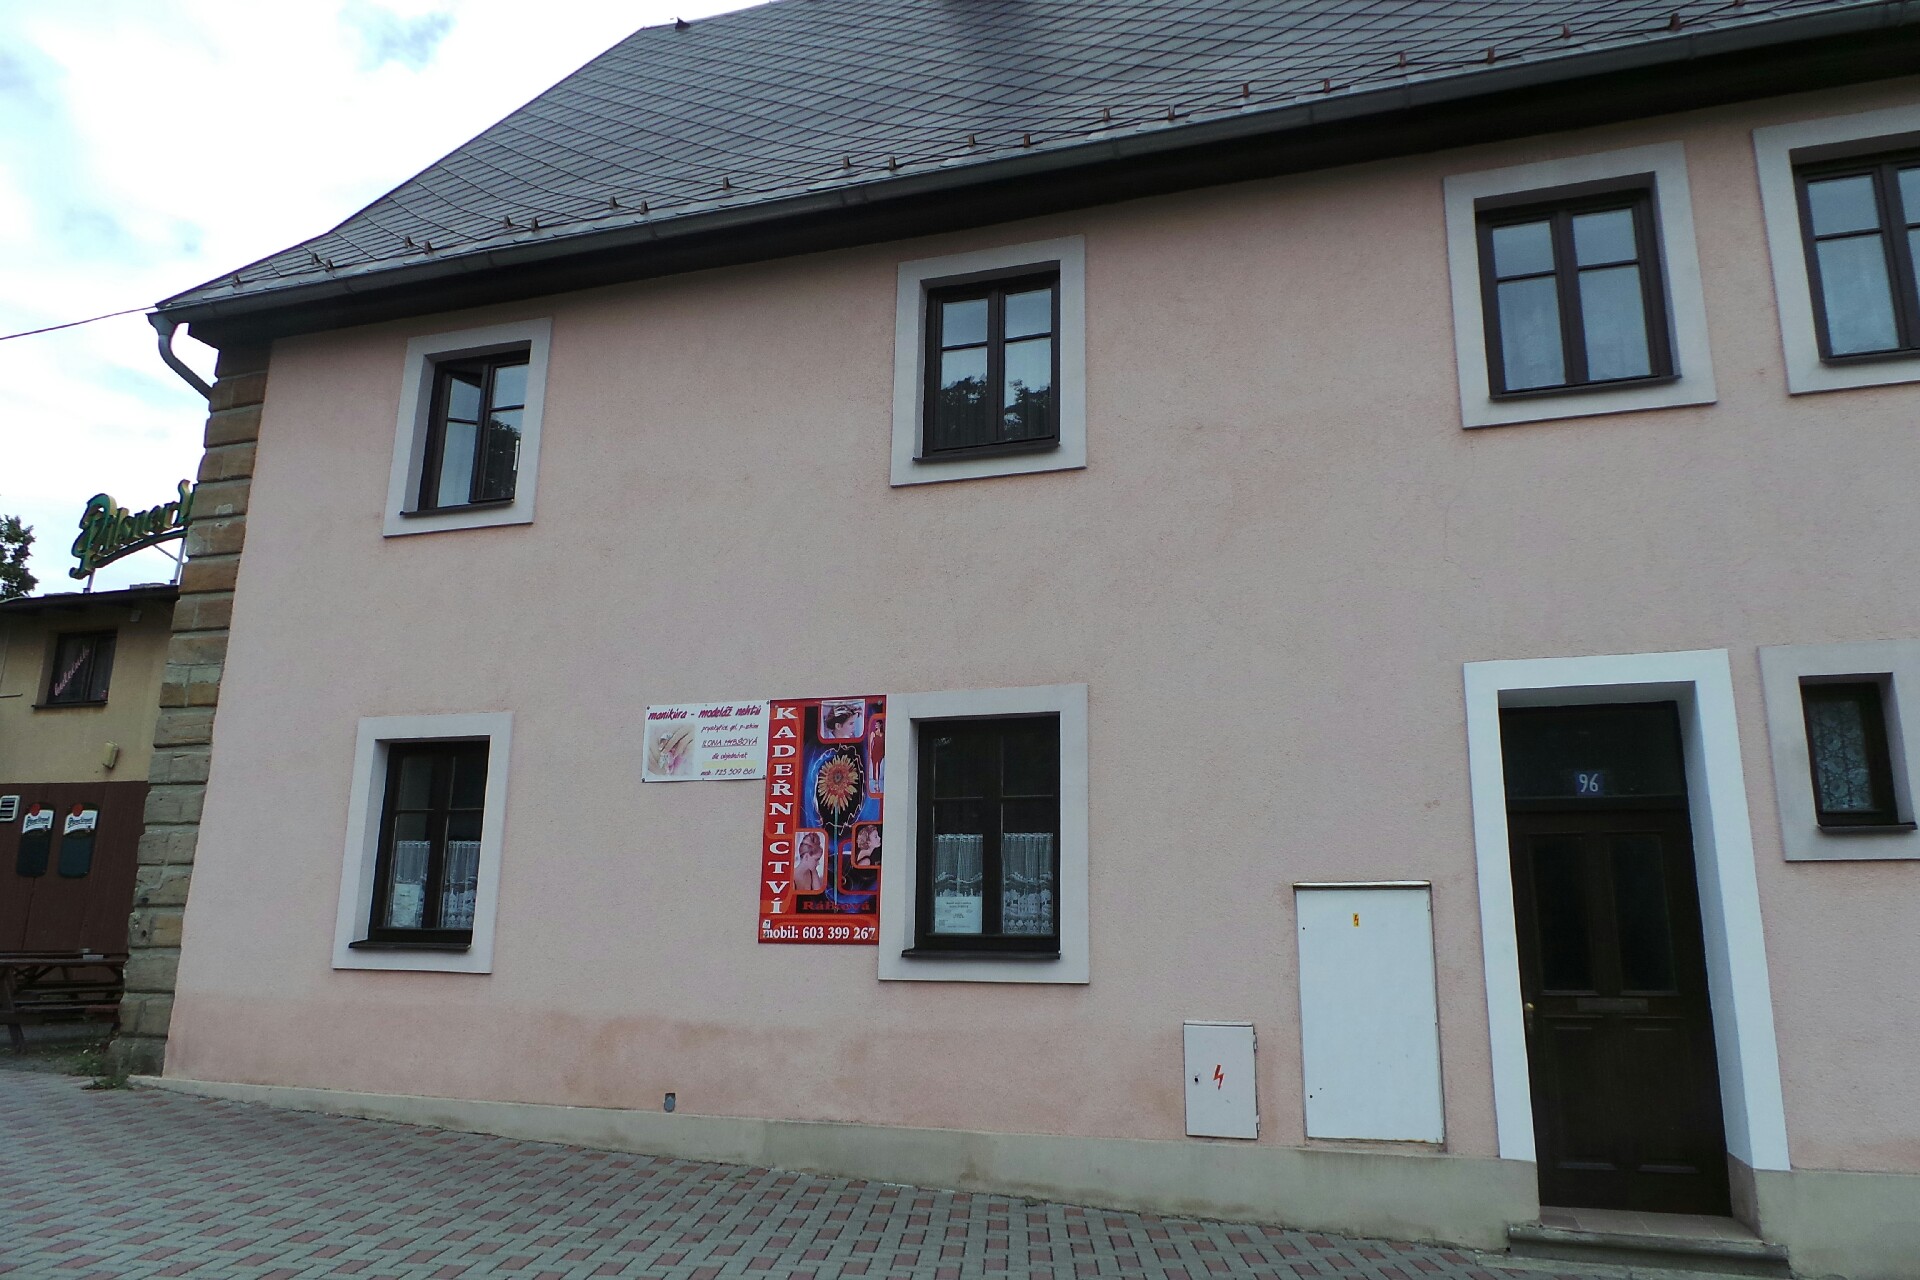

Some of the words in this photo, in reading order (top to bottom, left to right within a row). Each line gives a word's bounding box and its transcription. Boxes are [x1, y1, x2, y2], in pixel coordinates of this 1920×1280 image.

[648, 708, 688, 720] manikúra
[698, 706, 734, 719] modeláž
[735, 704, 761, 717] nehtů
[1579, 773, 1599, 793] 96
[766, 707, 798, 914] KADEŘNICTVÍ
[763, 926, 799, 939] mobil:
[802, 926, 824, 939] 603
[828, 926, 850, 939] 399
[853, 927, 876, 940] 267
